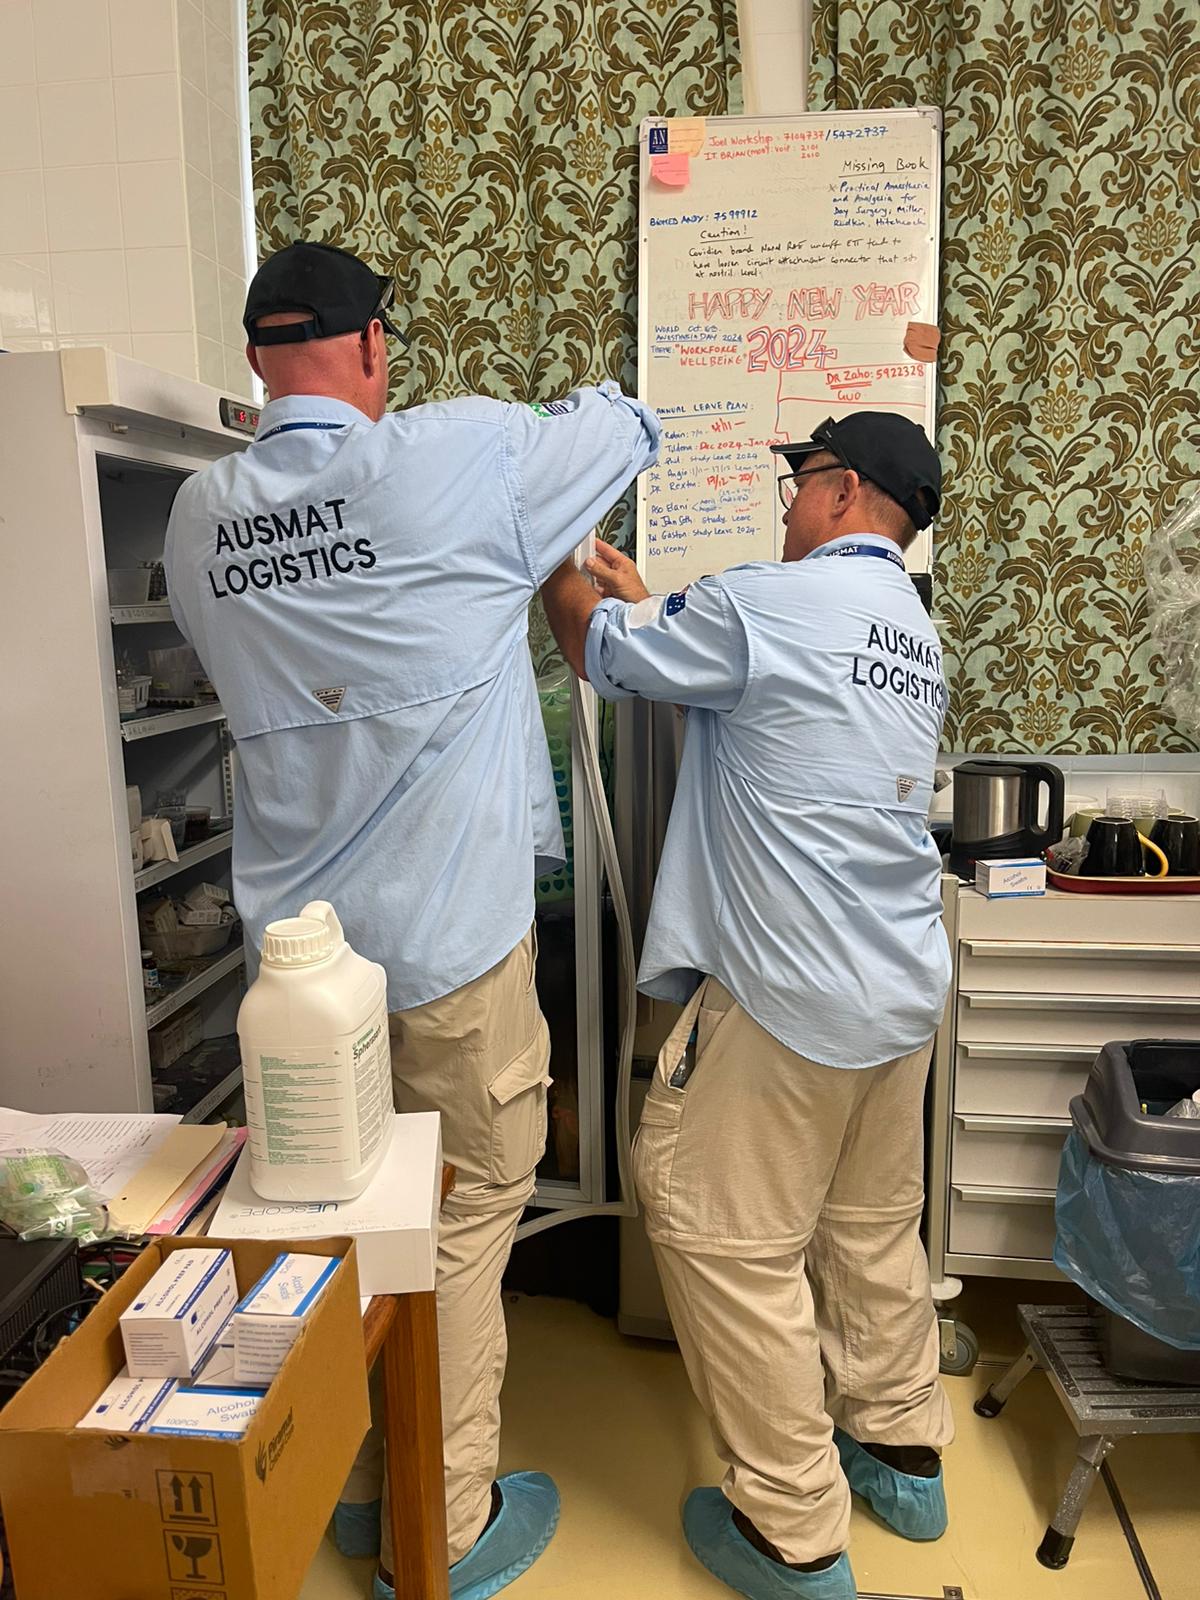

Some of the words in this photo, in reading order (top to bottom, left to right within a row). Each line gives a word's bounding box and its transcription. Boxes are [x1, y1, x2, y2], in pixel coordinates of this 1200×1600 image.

[843, 158, 885, 173] Missing
[896, 157, 929, 170] Book
[901, 194, 917, 203] for
[833, 208, 849, 216] Day
[878, 254, 899, 264] that
[688, 288, 774, 320] HAPPY
[787, 287, 843, 320] NEW
[852, 281, 921, 320] YEAR
[747, 324, 838, 373] 2024
[693, 401, 722, 411] LEAVE
[215, 499, 346, 555] AUSMAT
[208, 537, 377, 599] LOGISTICS
[867, 623, 941, 676] AUSMAT
[852, 656, 944, 711] LOGISTIC
[239, 1202, 339, 1217] UESCOPE
[206, 1398, 256, 1417] Alcohol
